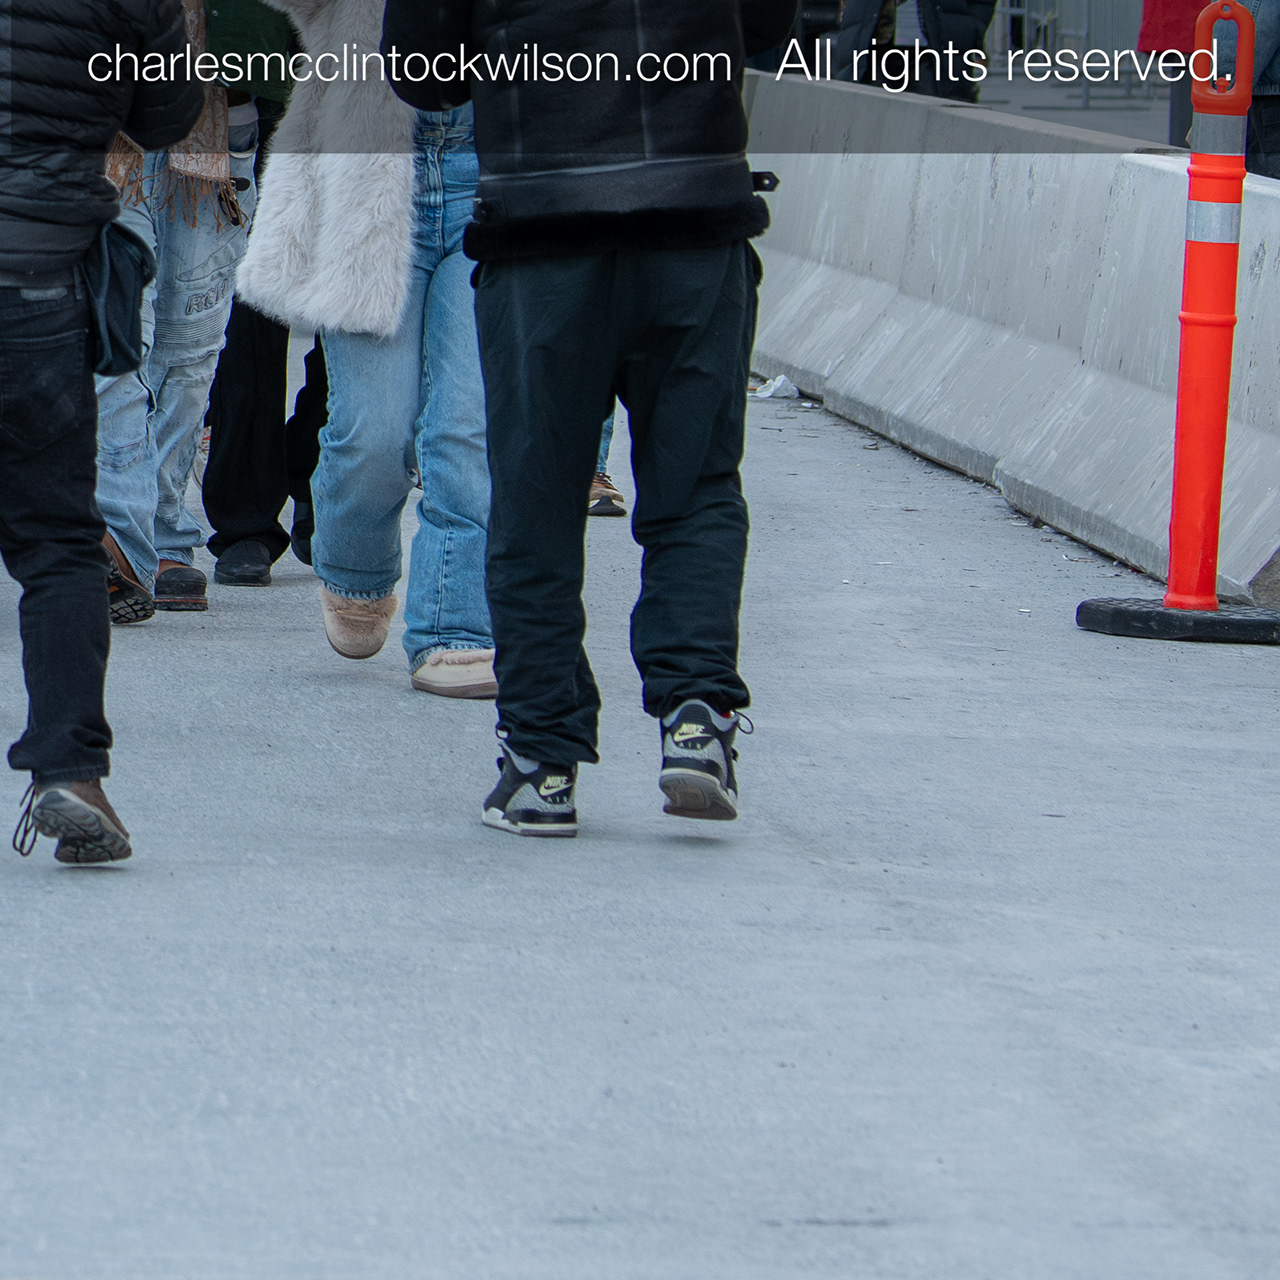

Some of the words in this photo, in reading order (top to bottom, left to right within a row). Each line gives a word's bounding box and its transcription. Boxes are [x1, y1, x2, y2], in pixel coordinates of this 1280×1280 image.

[679, 723, 706, 734] NIKE
[678, 742, 702, 750] AIR
[544, 775, 569, 788] NIKE
